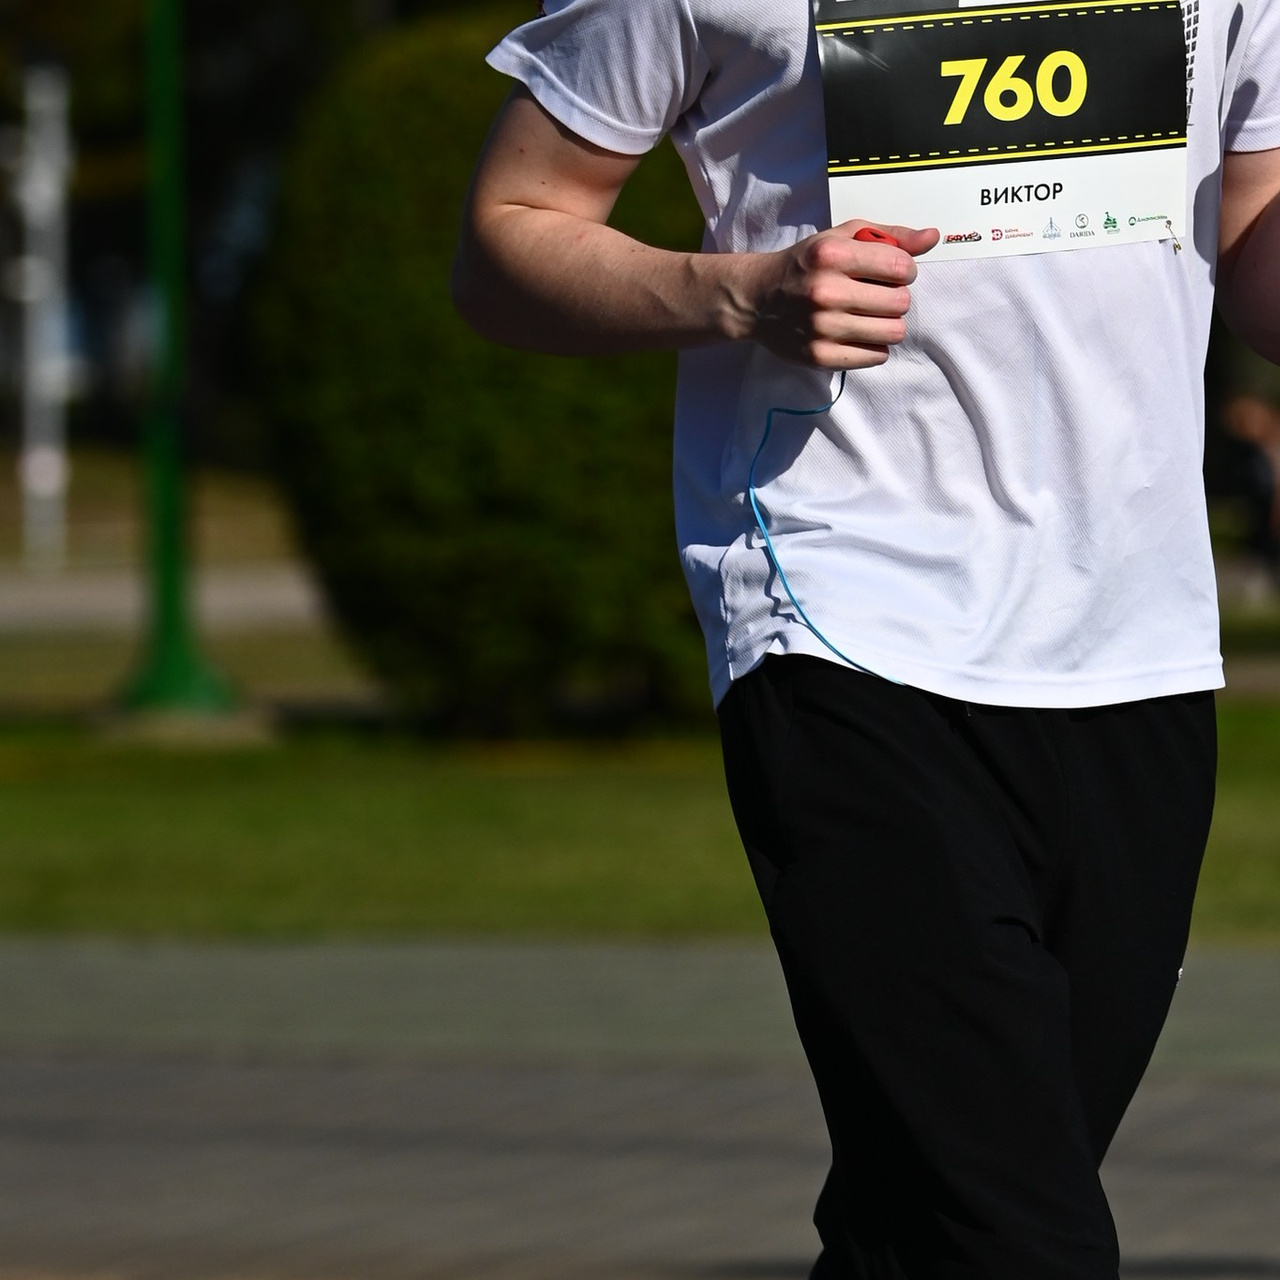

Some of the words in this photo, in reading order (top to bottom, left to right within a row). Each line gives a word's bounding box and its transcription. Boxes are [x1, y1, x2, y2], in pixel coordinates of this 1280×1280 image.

[940, 50, 1088, 126] 760
[980, 182, 1063, 206] ВИКТОР
[1069, 230, 1096, 239] DARIDA
